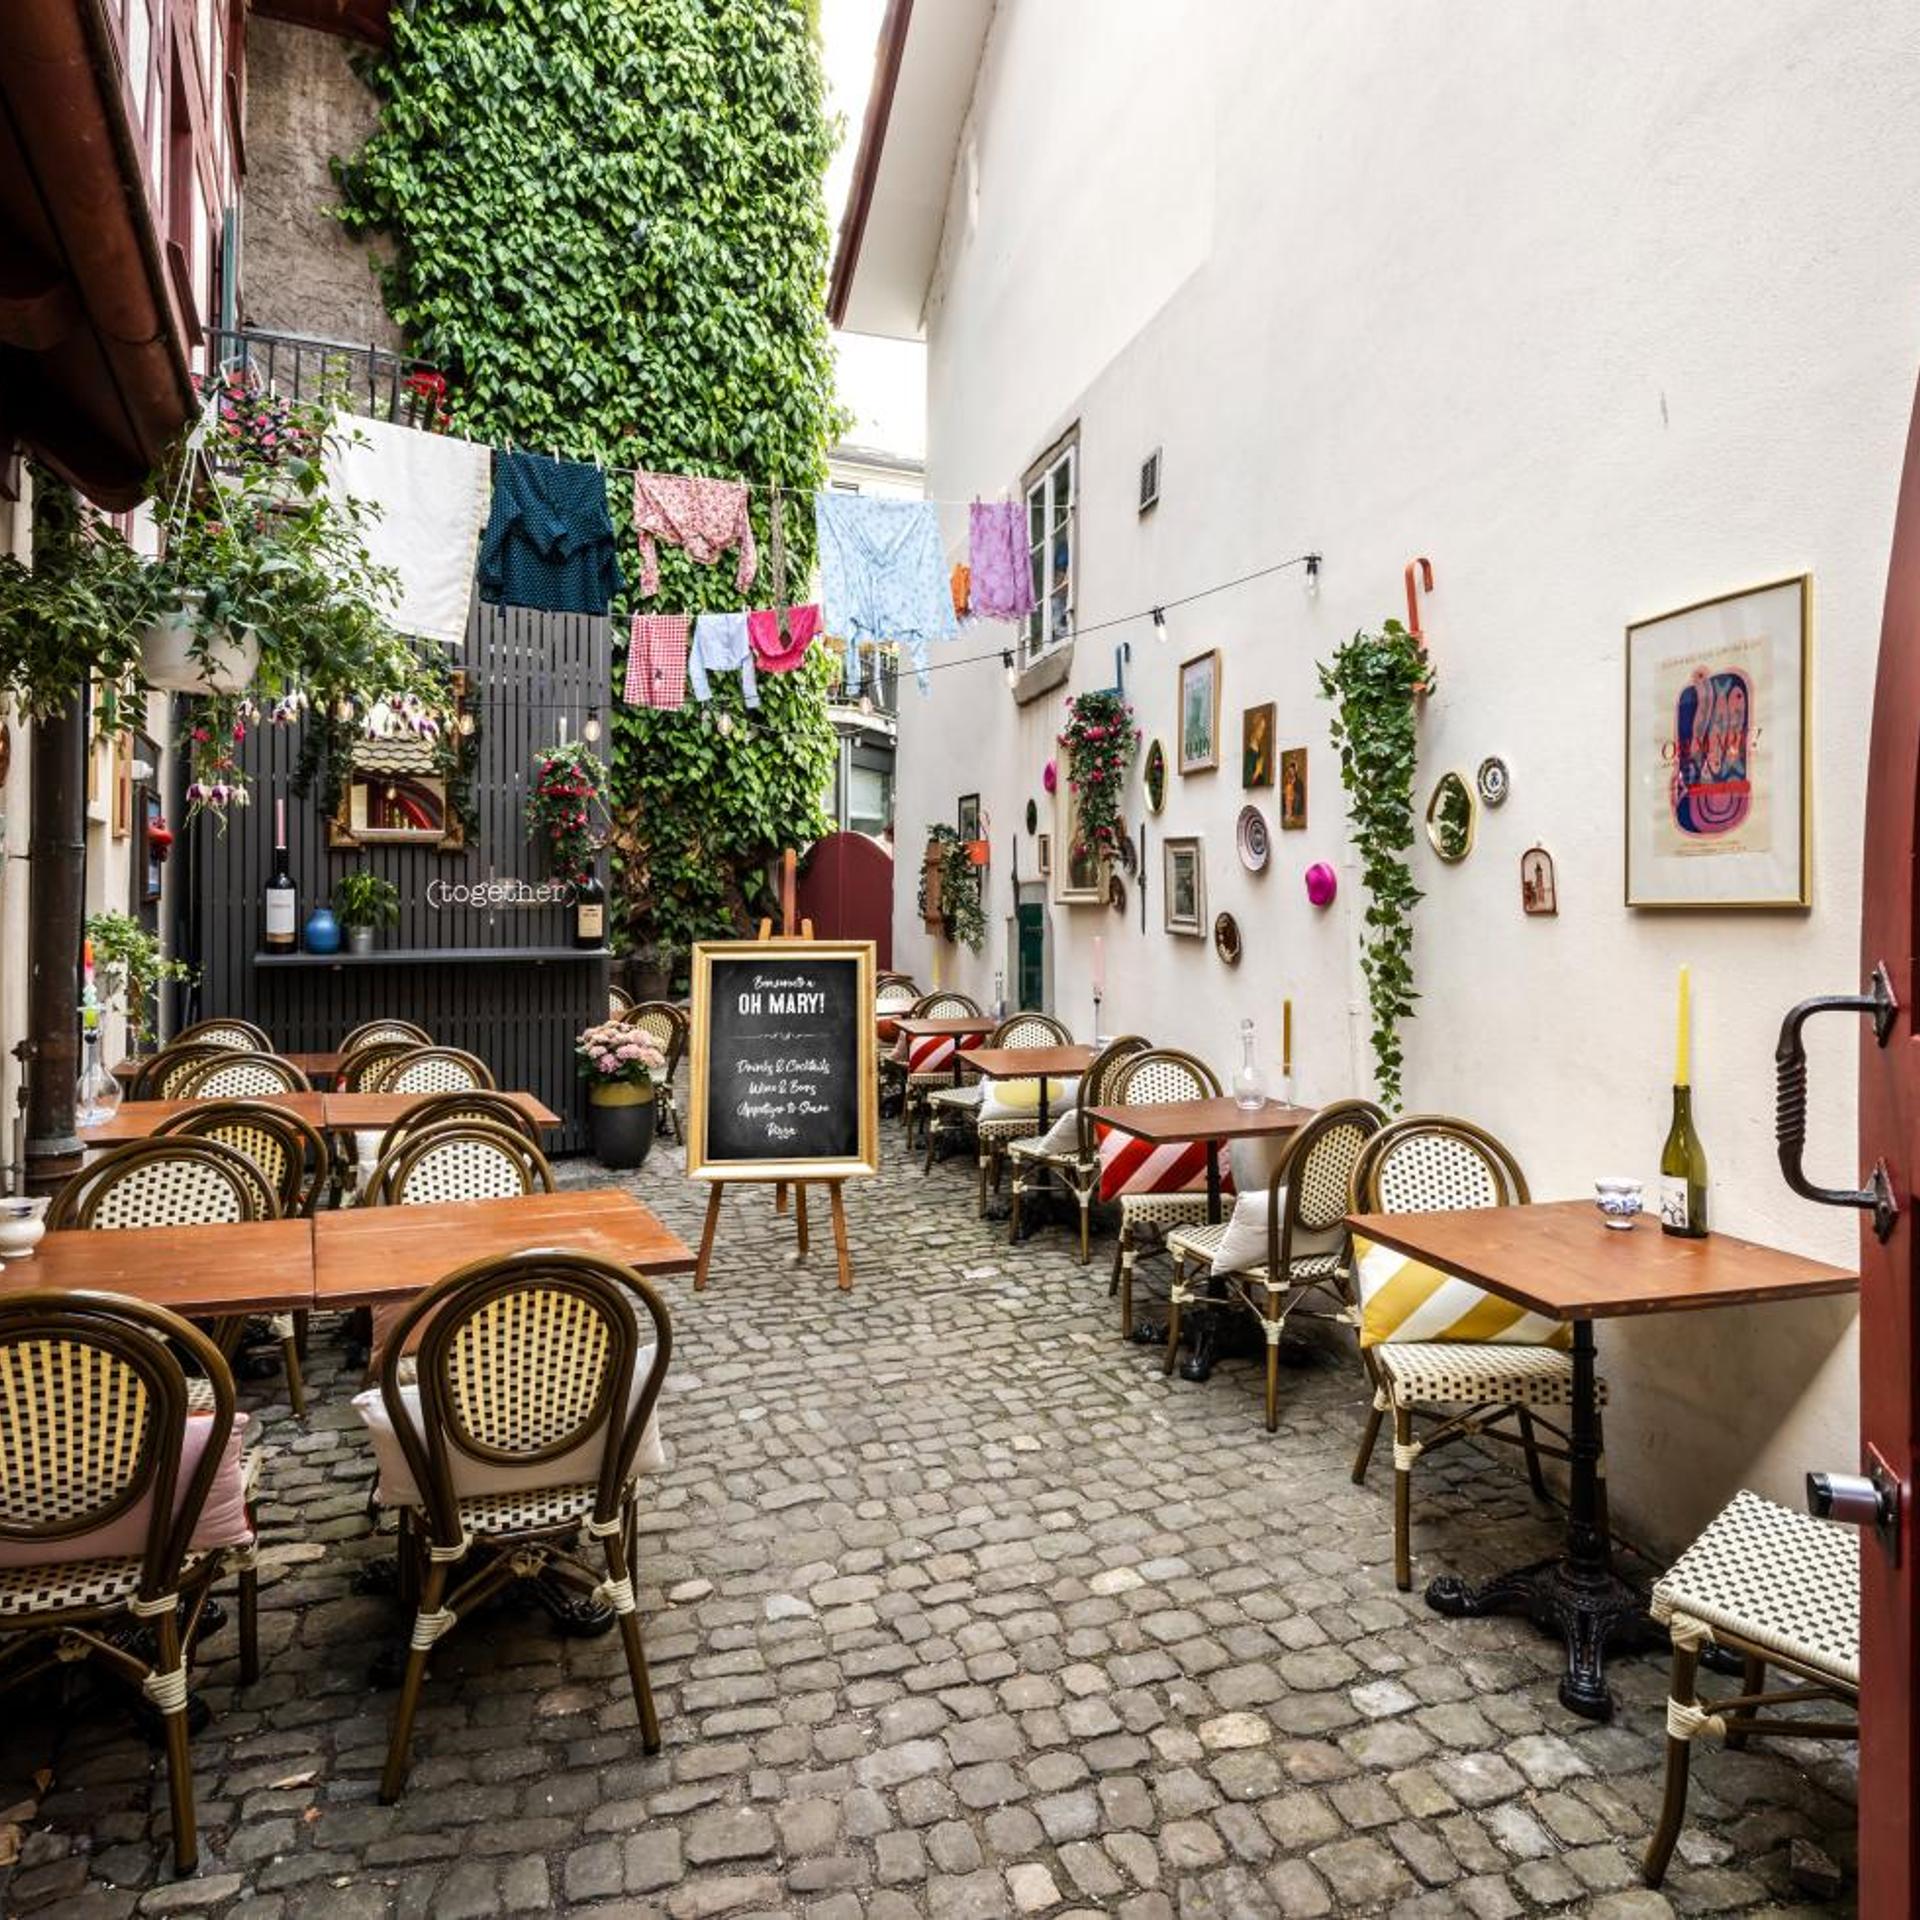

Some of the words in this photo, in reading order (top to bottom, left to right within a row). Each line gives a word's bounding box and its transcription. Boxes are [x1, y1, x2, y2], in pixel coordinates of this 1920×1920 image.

[739, 993, 761, 1014] OH
[769, 993, 824, 1014] MARY!
[736, 1059, 773, 1076] Drinks
[776, 1058, 785, 1073] &
[786, 1058, 830, 1074] Cocktails
[778, 1079, 787, 1094] &
